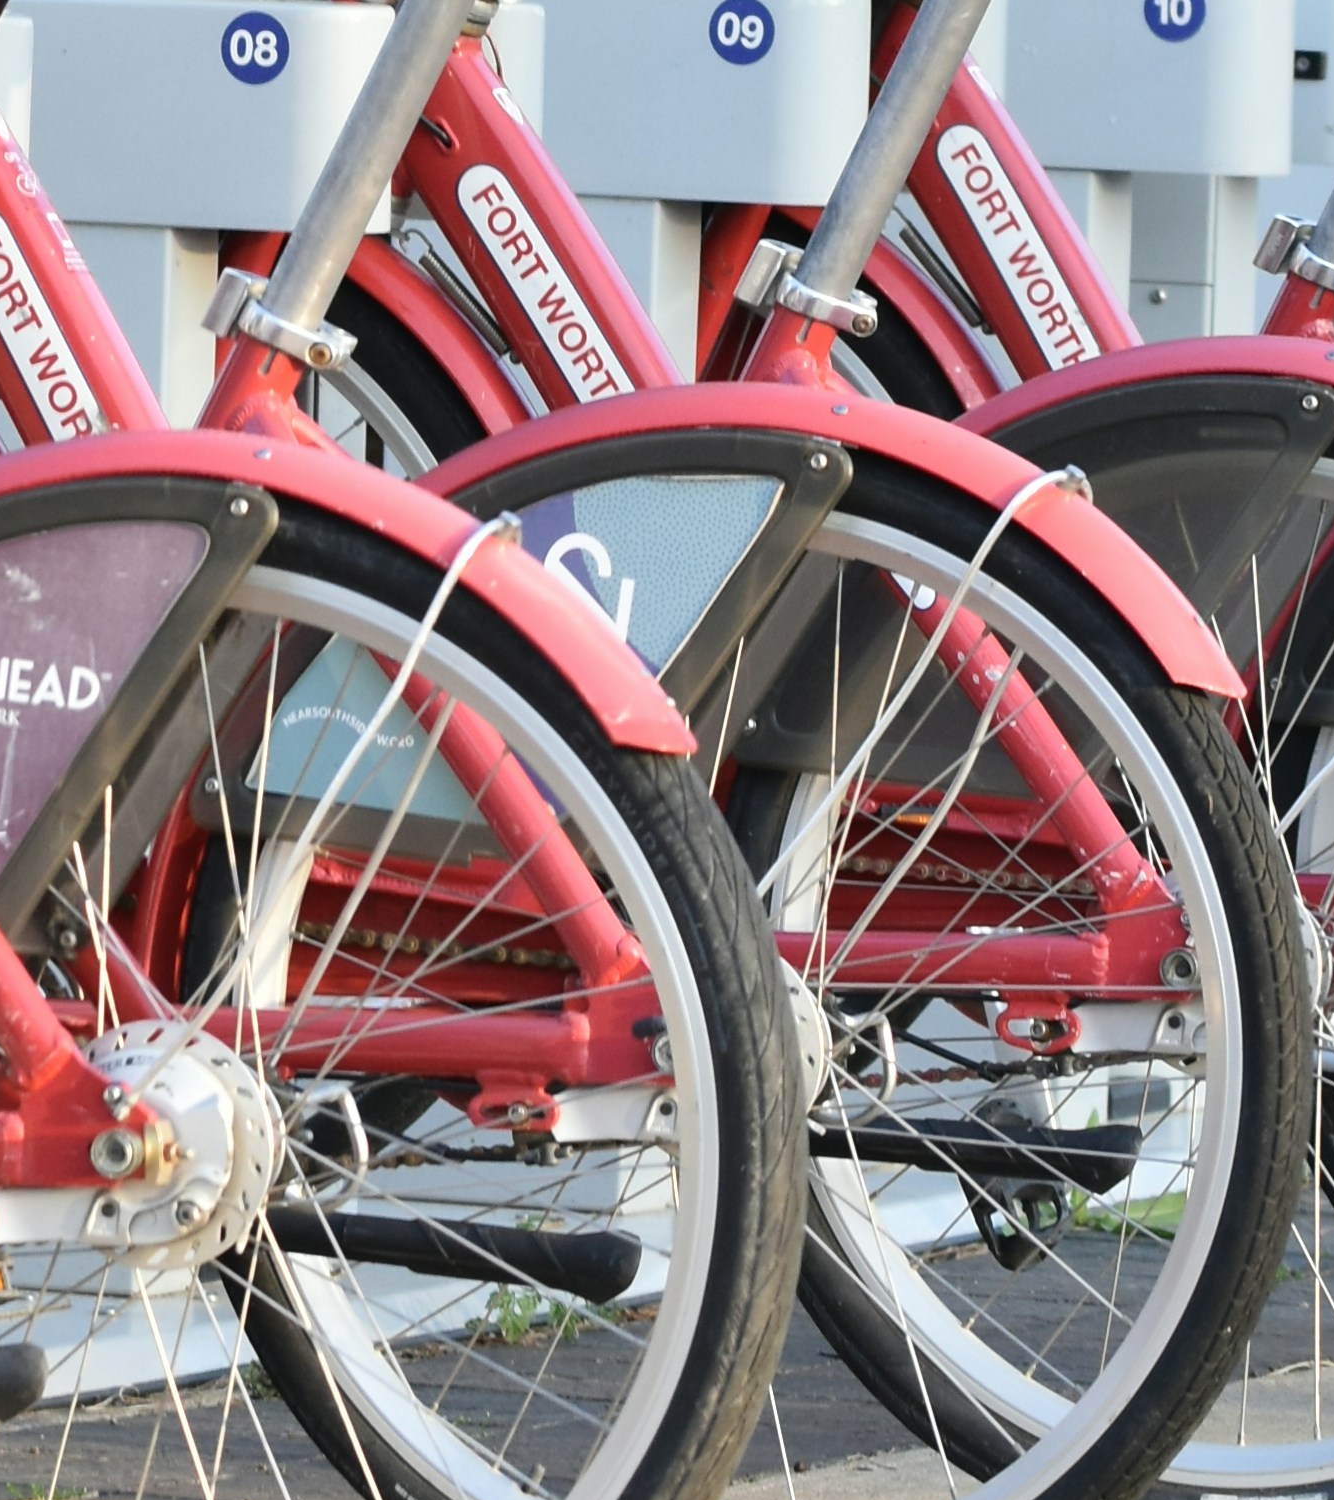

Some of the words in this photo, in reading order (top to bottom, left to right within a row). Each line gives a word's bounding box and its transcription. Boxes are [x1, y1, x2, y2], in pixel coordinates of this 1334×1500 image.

[229, 28, 279, 67] 08
[717, 12, 764, 50] 09
[951, 142, 1022, 237] FORT
[472, 182, 549, 280] FORT
[537, 282, 620, 397] WORT
[29, 338, 93, 439] WOR
